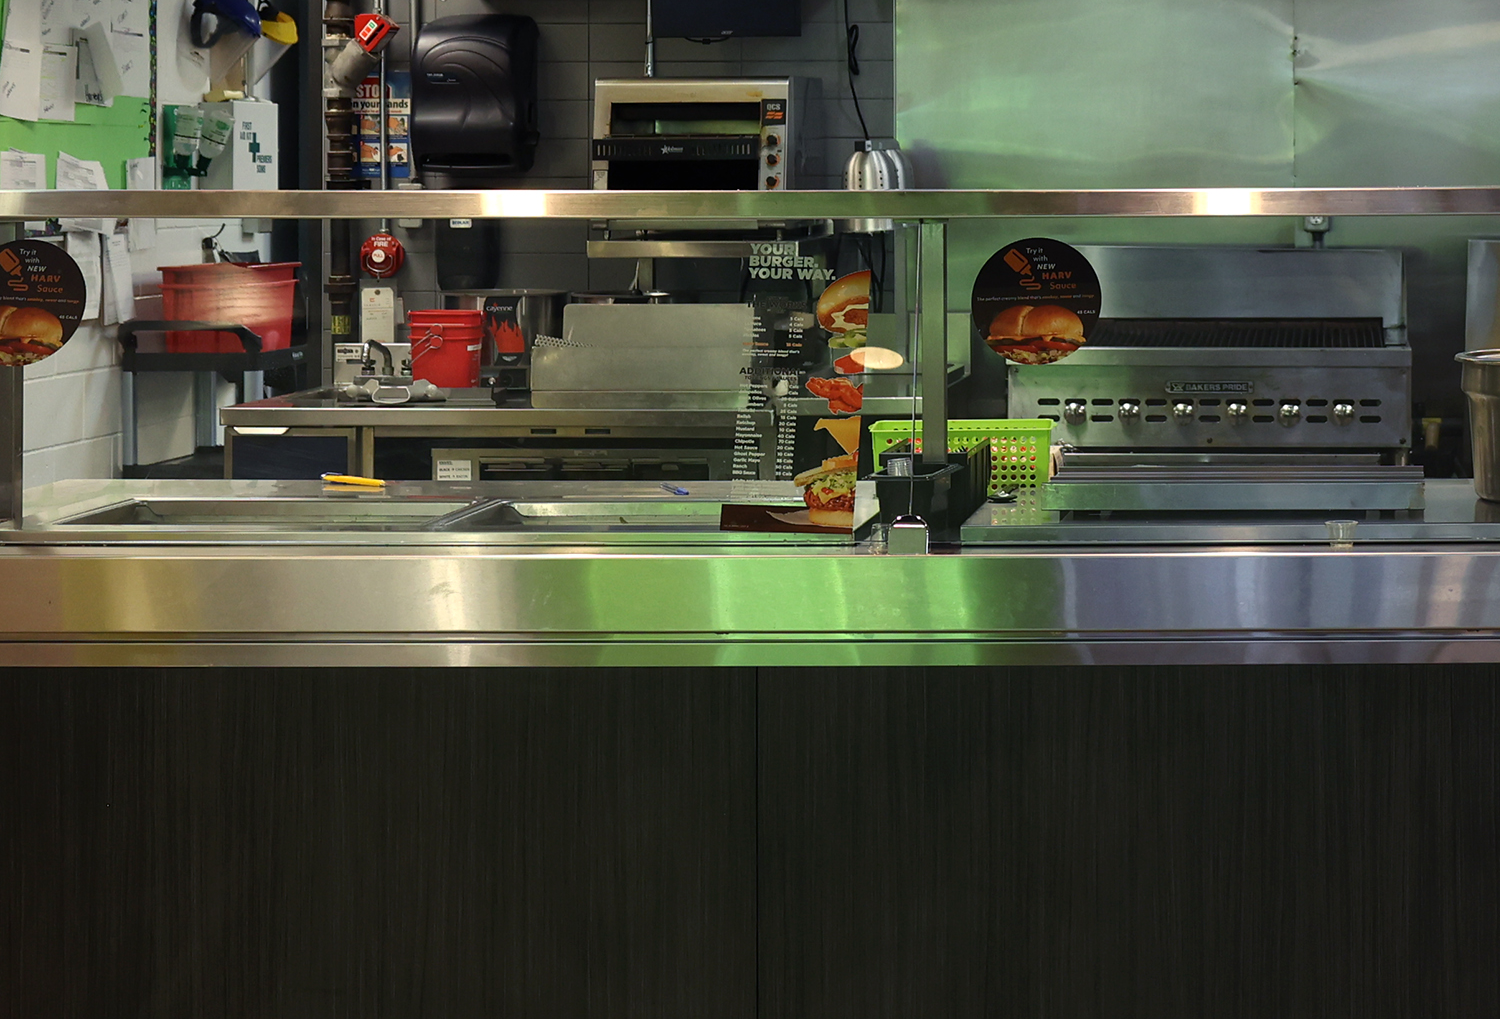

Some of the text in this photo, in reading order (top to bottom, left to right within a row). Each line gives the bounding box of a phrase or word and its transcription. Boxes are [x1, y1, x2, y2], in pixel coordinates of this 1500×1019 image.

[242, 121, 252, 130] FIRST
[750, 244, 796, 255] YOUR
[749, 256, 818, 268] BURGER.
[749, 268, 836, 280] YOUR WAY.
[37, 285, 63, 293] Sauce
